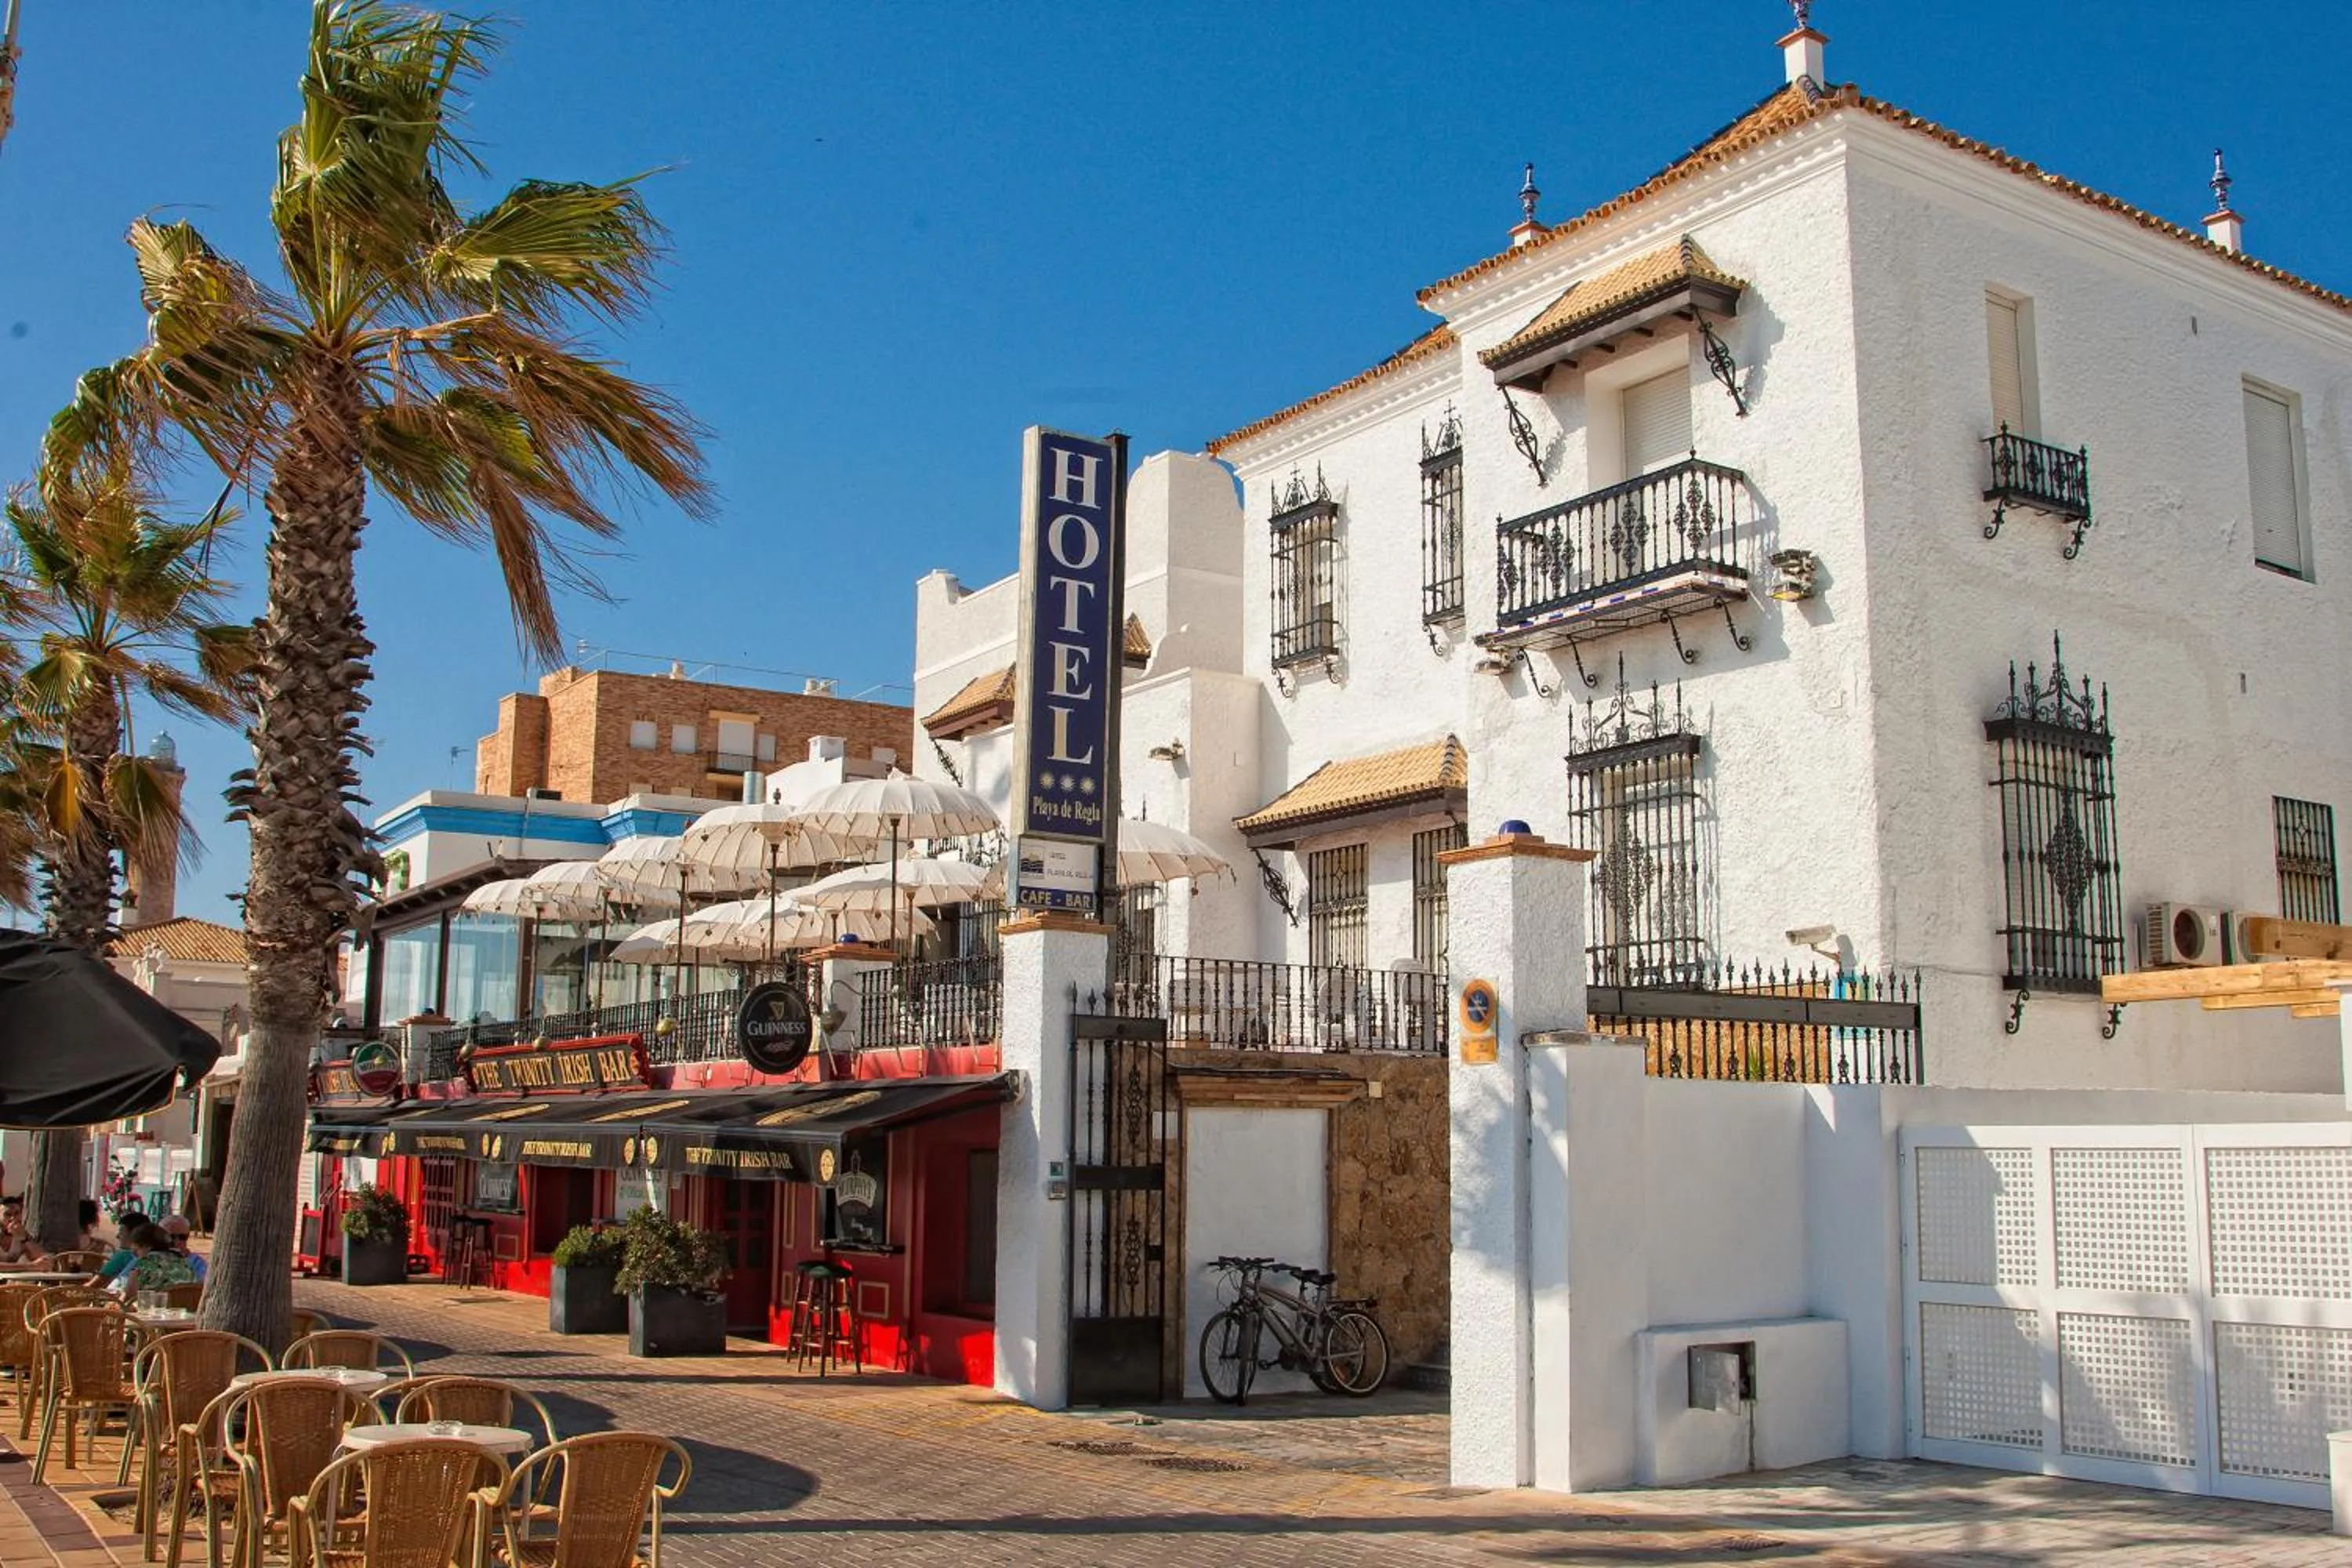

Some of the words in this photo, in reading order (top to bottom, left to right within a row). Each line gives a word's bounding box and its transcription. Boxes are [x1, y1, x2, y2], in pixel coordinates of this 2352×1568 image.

[1047, 447, 1103, 765] HOTEL
[1033, 796, 1058, 821] Playa
[1061, 800, 1072, 818] de
[1075, 800, 1101, 826] Regla
[1020, 890, 1051, 905] CAFE
[1066, 893, 1091, 909] BAR
[747, 1020, 806, 1036] GUINNESS
[476, 1062, 503, 1089] THE
[506, 1057, 554, 1087] TRINITY
[557, 1053, 594, 1084] IRISH
[597, 1051, 630, 1083] BAR
[739, 1150, 769, 1167] IRISH
[769, 1152, 793, 1169] BAR
